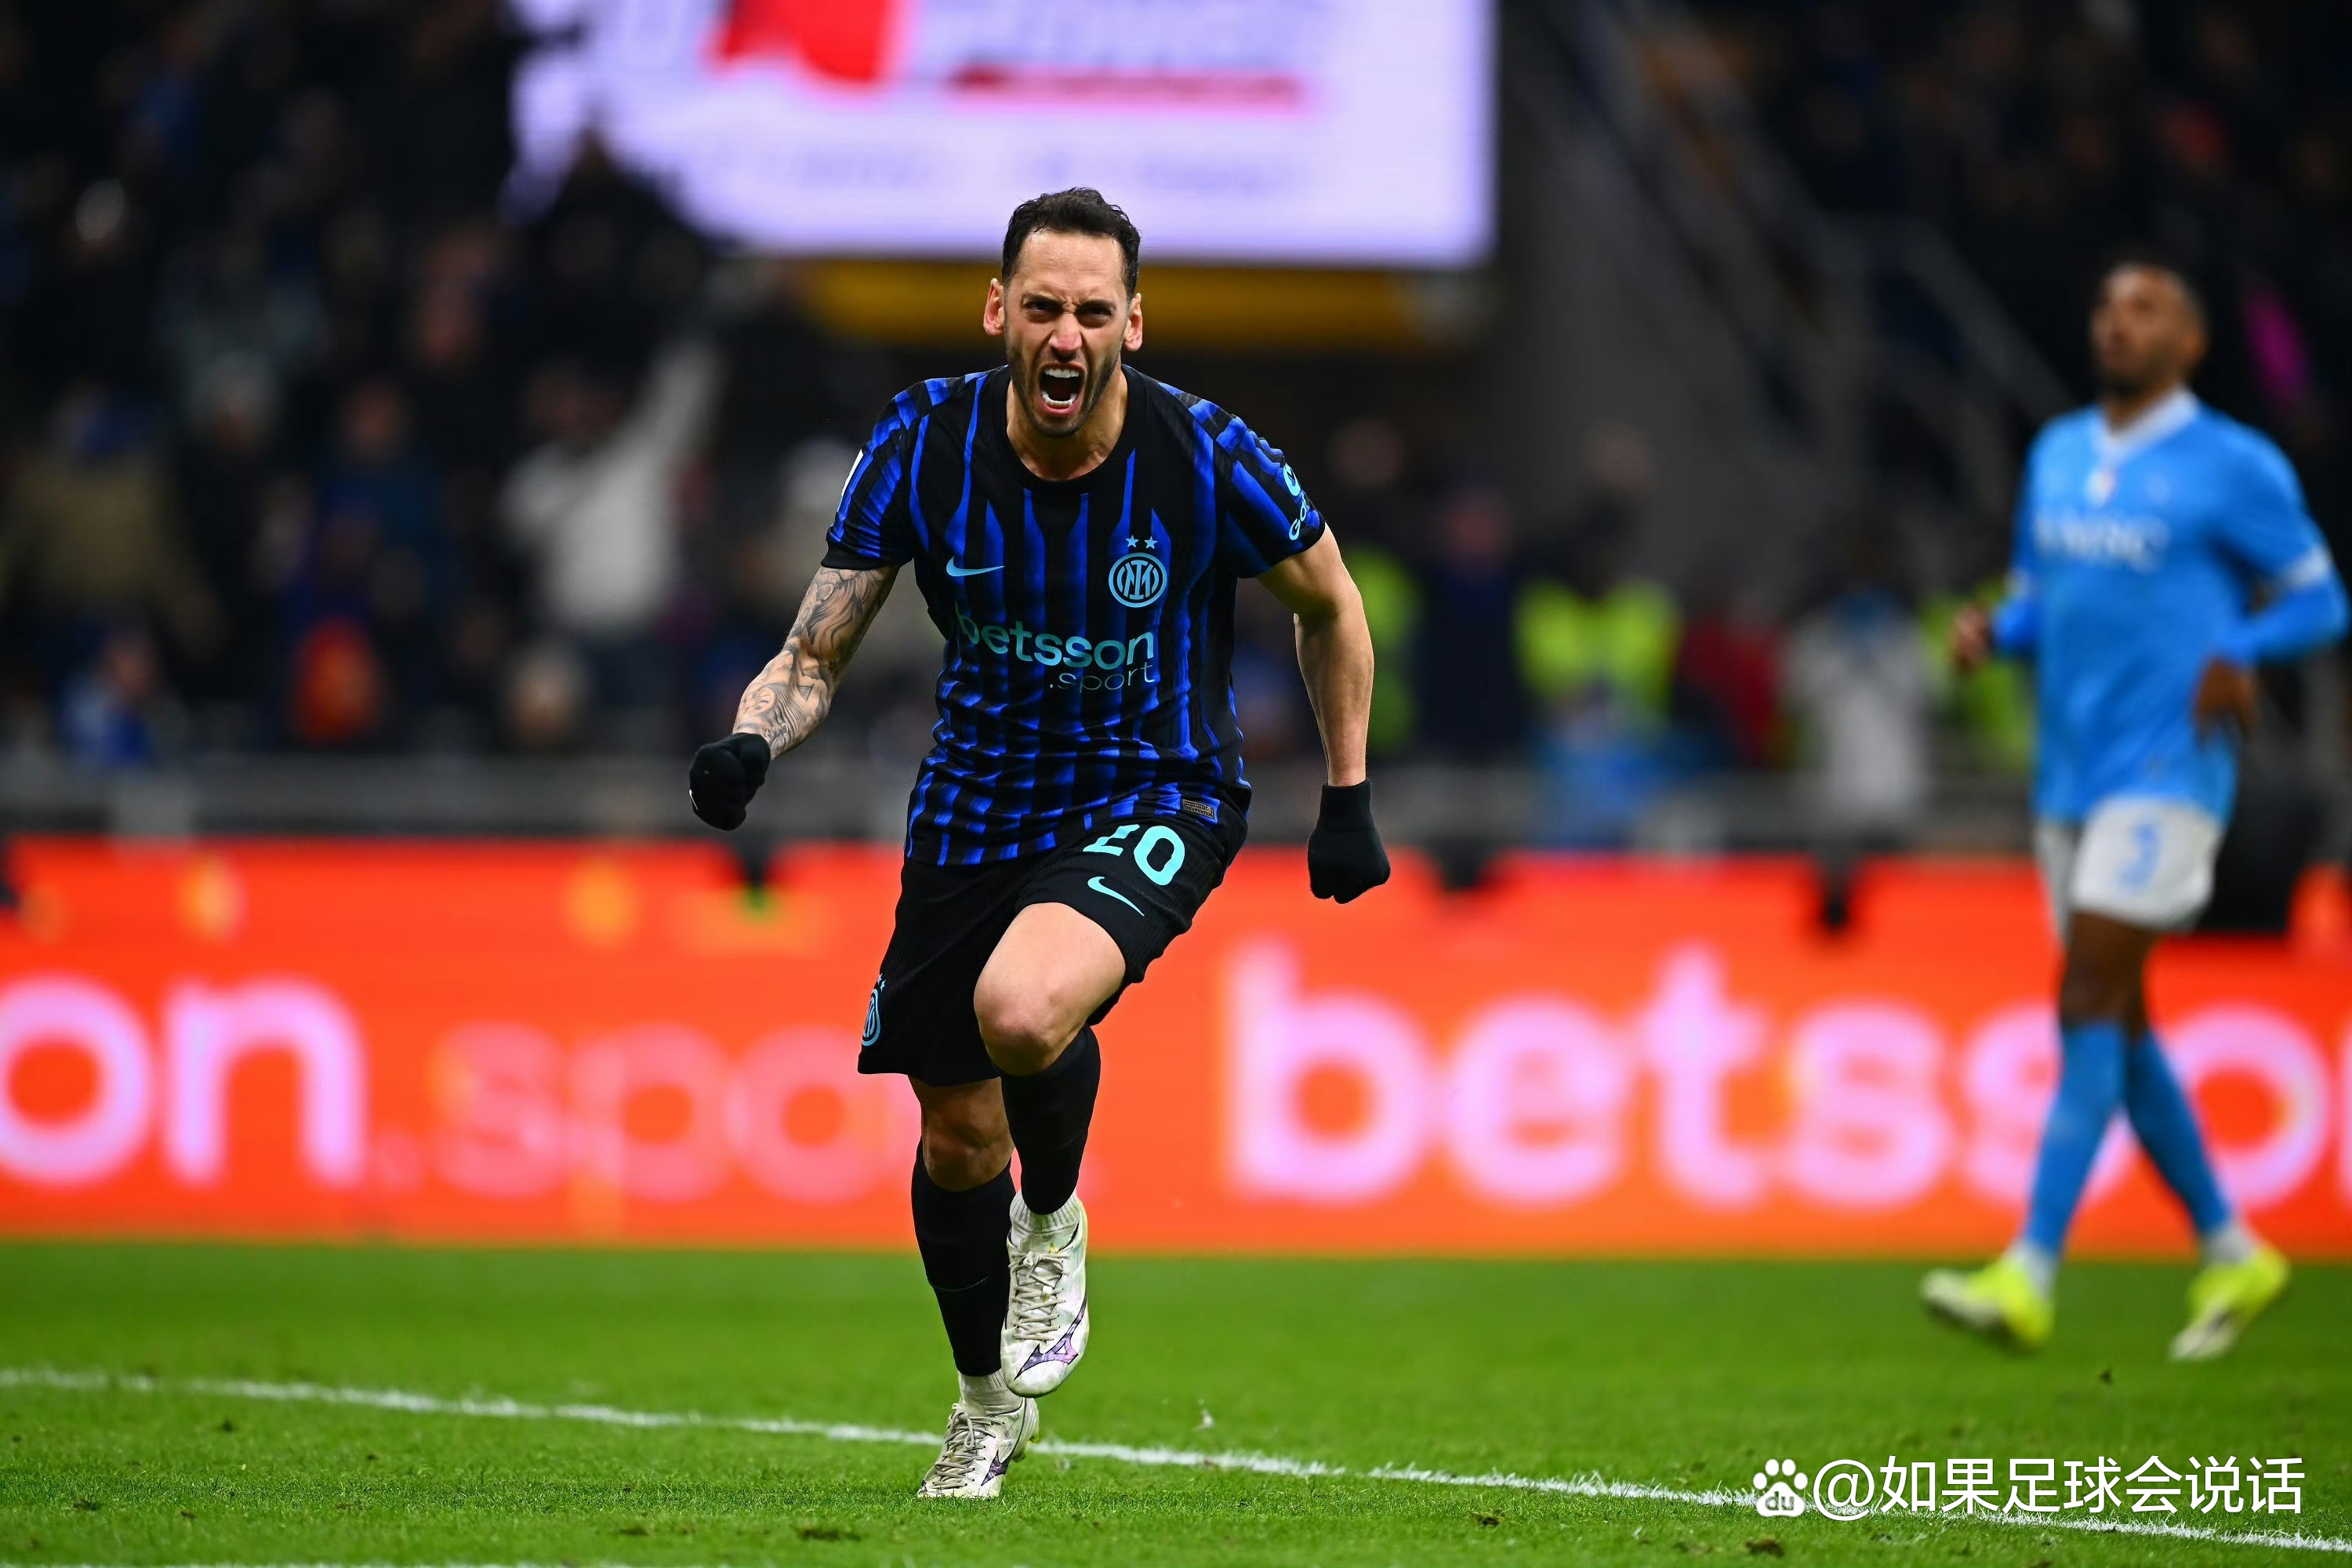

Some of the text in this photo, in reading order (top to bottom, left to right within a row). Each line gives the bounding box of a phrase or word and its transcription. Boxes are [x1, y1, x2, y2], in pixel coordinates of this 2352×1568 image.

[955, 601, 1155, 670] betsson
[1082, 824, 1185, 886] 20
[1223, 939, 2352, 1207] betsso
